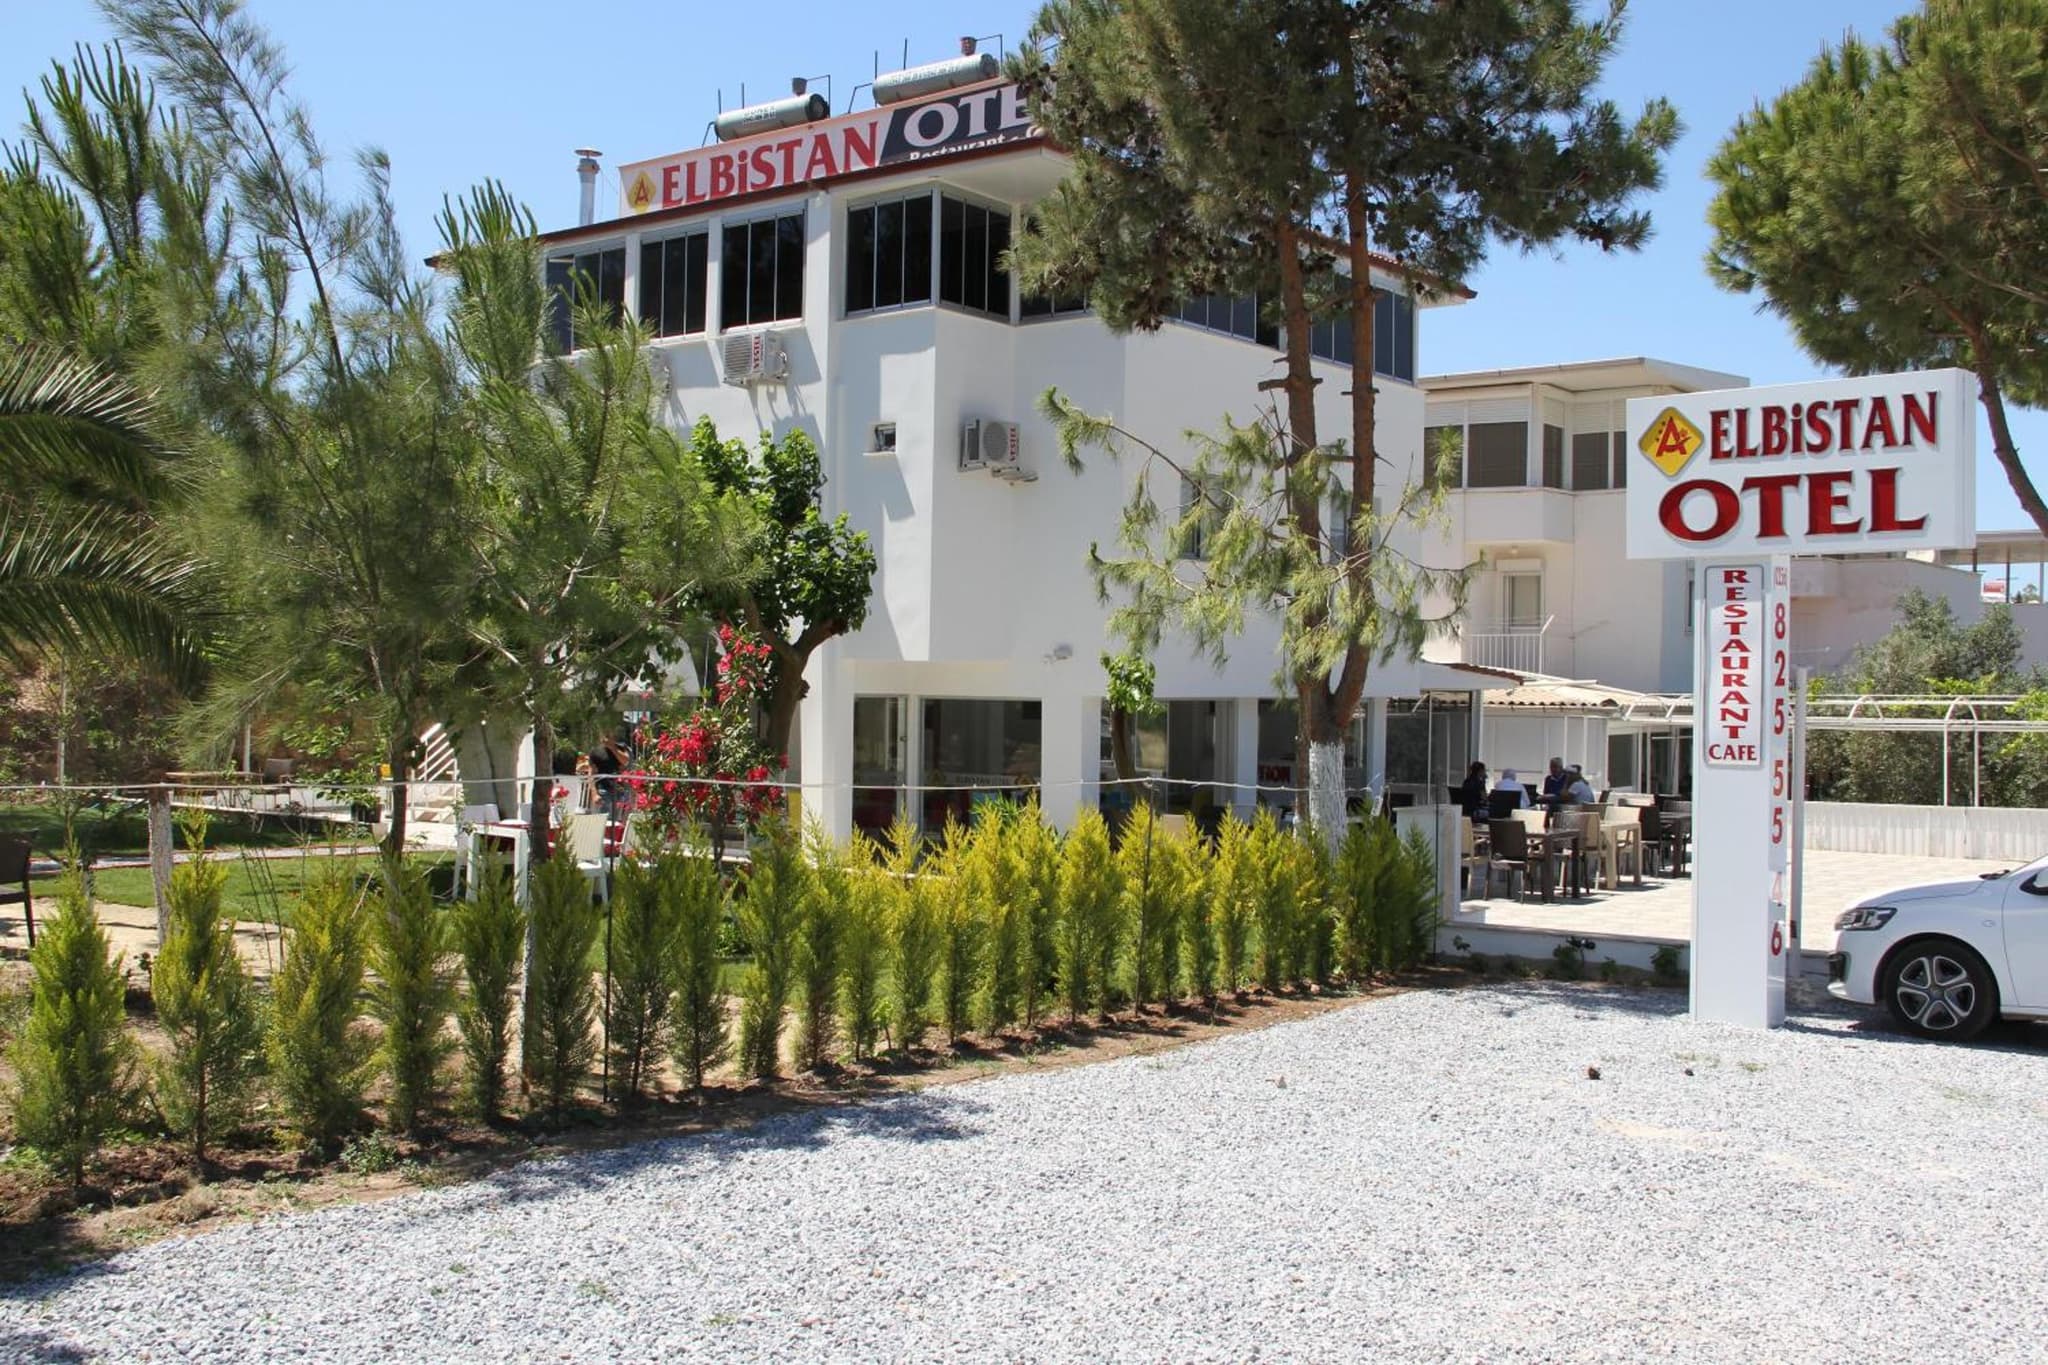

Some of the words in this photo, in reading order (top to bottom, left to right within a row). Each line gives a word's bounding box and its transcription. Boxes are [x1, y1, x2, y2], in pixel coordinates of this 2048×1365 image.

[904, 84, 1033, 147] OTE
[1658, 467, 1930, 541] OTEL
[1719, 570, 1751, 739] RESTAURANT
[1708, 744, 1757, 761] CAFE
